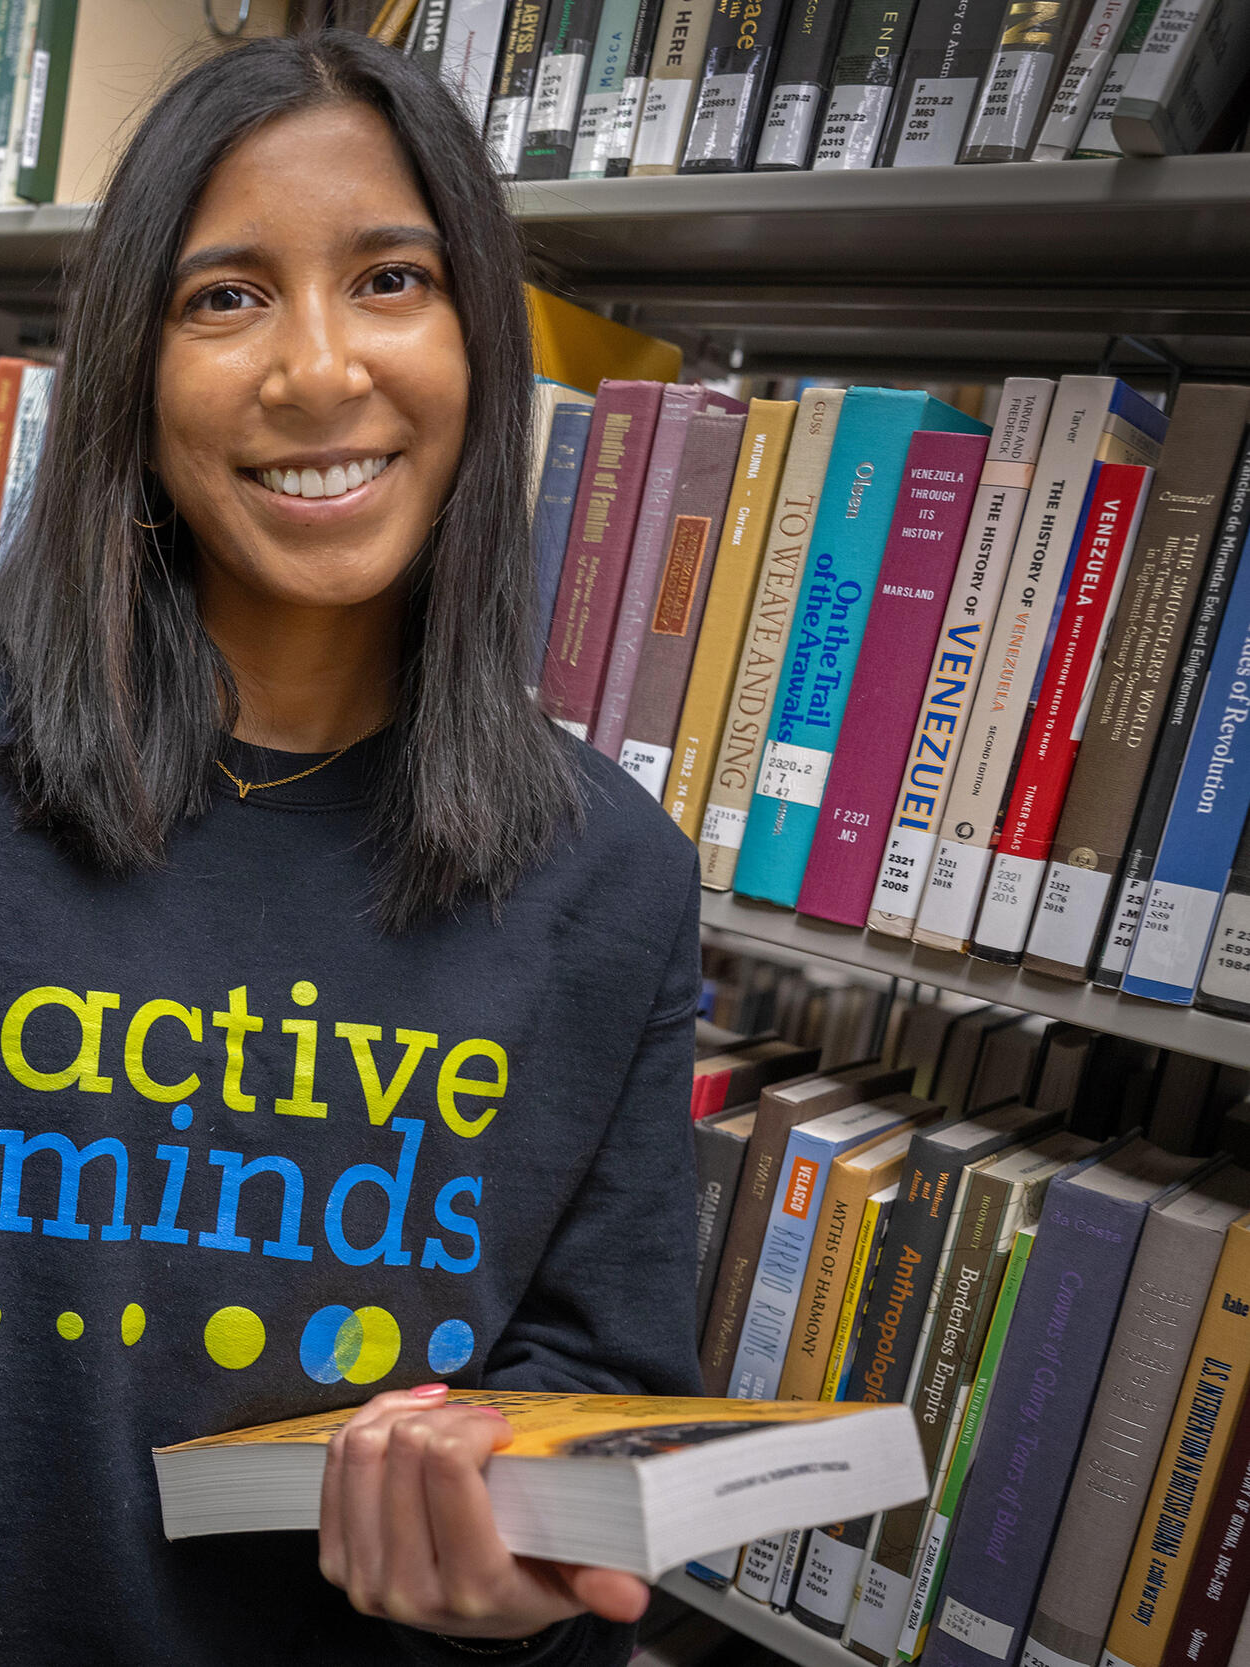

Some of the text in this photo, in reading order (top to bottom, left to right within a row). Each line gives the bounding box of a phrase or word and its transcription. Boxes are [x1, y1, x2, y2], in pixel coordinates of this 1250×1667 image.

[1159, 9, 1200, 22] 2279.22
[516, 4, 541, 54] ABYSS
[666, 11, 692, 66] HERE
[874, 11, 899, 58] END
[951, 24, 962, 35] of
[1150, 32, 1179, 44] A313
[600, 32, 622, 87] MOSCA
[995, 69, 1019, 79] 2281
[1067, 66, 1092, 77] 2281
[991, 82, 1008, 92] .D2
[1062, 79, 1081, 88] .D2
[915, 96, 954, 106] 2279.22
[987, 94, 1009, 104] M35
[827, 113, 867, 123] 2279.22
[911, 108, 936, 118] .M63
[982, 106, 1007, 116] 2016
[1051, 105, 1078, 115] 2018
[823, 126, 846, 135] .B48
[908, 120, 929, 130] C85
[820, 138, 846, 147] A313
[905, 132, 930, 141] 2017
[817, 150, 841, 159] 2010
[809, 401, 825, 436] GUSS
[1018, 394, 1037, 434] TARVER
[998, 397, 1022, 454] FREDERICK
[1067, 408, 1087, 444] Tarver
[583, 413, 633, 544] Mindful of Famine
[910, 467, 965, 483] VENEZUELA
[732, 434, 766, 546] WATUNNA Civrieux
[846, 462, 874, 519] Olsen
[910, 487, 956, 502] THROUGH
[918, 508, 936, 521] ITS
[901, 526, 945, 542] HISTORY
[1176, 533, 1200, 571] THE
[659, 526, 689, 627] ARCHAEOLOGY
[672, 532, 700, 621] VENEZUELAN
[882, 584, 935, 601] MARSLAND
[990, 479, 1066, 713] THE HISTORY OF VENEZUELA
[1045, 499, 1122, 731] VENEZUELA WHAT EVERYONE NEEDS TO
[1170, 516, 1242, 727] de Miranda: Exilio and Enlightenment
[719, 495, 816, 790] TO WEAVE AND SING
[777, 553, 838, 743] of the Arawaks
[1110, 535, 1181, 742] Illicit Trade and Atlantic Communities
[805, 580, 862, 728] On the Trail
[899, 493, 1006, 834] THE HISTORY OF VENEZUEL
[1126, 688, 1156, 750] WORLD
[1196, 680, 1250, 814] of Revolution
[634, 753, 655, 764] 2319
[680, 747, 697, 778] 2319.2
[768, 757, 813, 776] 2320.2
[971, 725, 998, 797] SECOND EDITION
[843, 810, 870, 827] 2321
[1010, 784, 1037, 851] TINKER SALAS
[837, 828, 859, 844] .M3
[888, 854, 916, 867] 2321
[937, 857, 957, 869] 2321
[884, 868, 910, 880] .T24
[934, 868, 955, 879] .T24
[997, 870, 1022, 884] 2321
[881, 879, 910, 893] 2005
[931, 877, 953, 890] 2018
[994, 882, 1016, 894] .T56
[1049, 881, 1071, 893] 2322
[991, 891, 1018, 905] 2015
[1042, 901, 1066, 914] 2018
[1045, 892, 1068, 904] .C76
[1150, 899, 1175, 911] 2324
[1147, 909, 1170, 921] .S59
[1144, 920, 1169, 932] 2018
[0, 980, 509, 1139] active
[751, 1153, 773, 1201] EWALT
[789, 1165, 814, 1213] VELASCO
[921, 1181, 932, 1200] and
[929, 1171, 951, 1218] Whitehead
[971, 1194, 991, 1250] HOONHOUT
[1051, 1210, 1123, 1243] da Costa
[800, 1200, 849, 1358] MYTHS OF HARMONY
[743, 1224, 806, 1364] BARRIO RISING
[712, 1257, 749, 1368] Peripheral Wonders
[1222, 1293, 1250, 1317] Rabe
[863, 1244, 922, 1403] Anthropologie
[922, 1263, 980, 1425] Borderless Empire
[958, 1377, 989, 1446] WALTER RODNEY
[984, 1271, 1084, 1565] Crowns Glory, Tears of Blood
[1151, 1357, 1232, 1559] U.S. INTERVENTION IN BRITISH GUIANA
[1206, 1499, 1250, 1601] OF GUYANA, 1945-1983
[745, 1568, 770, 1585] 2007
[811, 1558, 833, 1576] 2351
[808, 1570, 830, 1585] .A67
[867, 1577, 888, 1591] 2351
[805, 1580, 828, 1597] 2009
[906, 1545, 939, 1631] 2380.6.R63 L48 2024
[1131, 1558, 1168, 1627] a cold war story
[863, 1595, 884, 1609] 2020
[1187, 1628, 1208, 1662] Spinner
